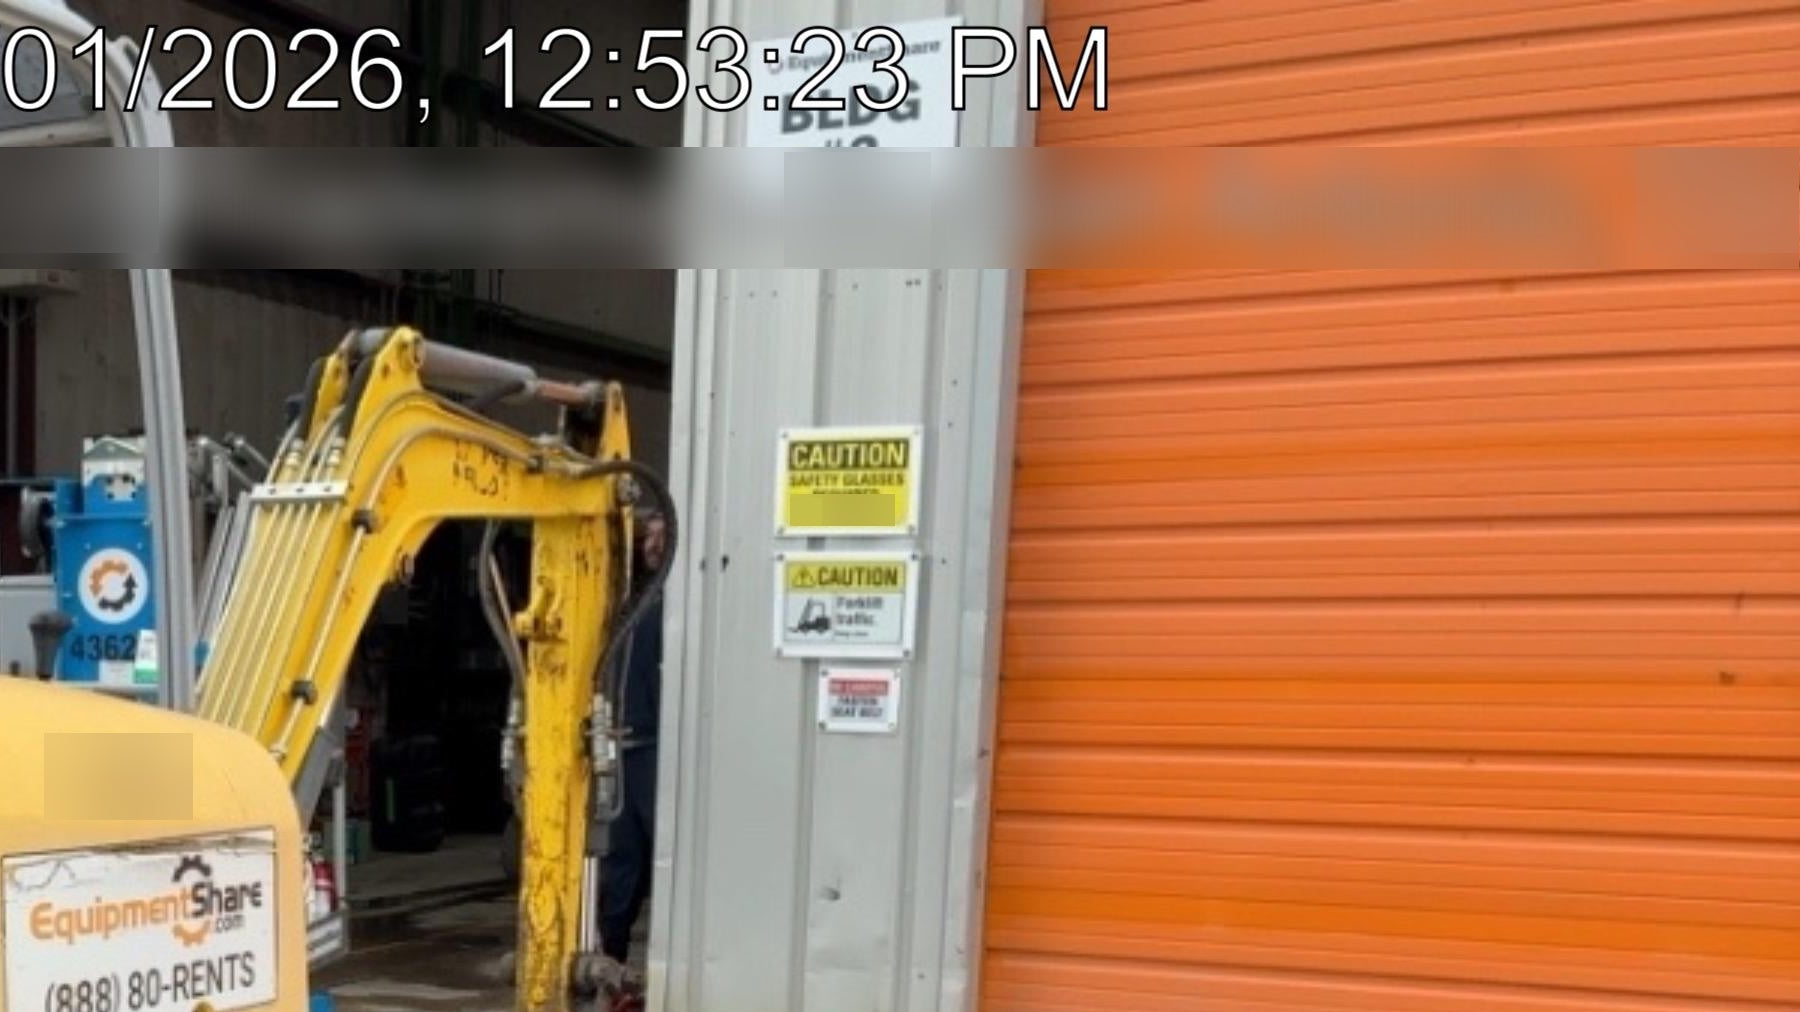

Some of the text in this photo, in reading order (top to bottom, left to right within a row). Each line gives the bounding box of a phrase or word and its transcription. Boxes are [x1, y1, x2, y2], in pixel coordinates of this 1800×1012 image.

[792, 442, 906, 469] CAUTION
[790, 473, 838, 487] SAFETY
[817, 565, 898, 587] CAUTION
[70, 634, 136, 662] 4362
[29, 880, 263, 946] EquipmentShare
[127, 950, 256, 1012] 80-RENTS
